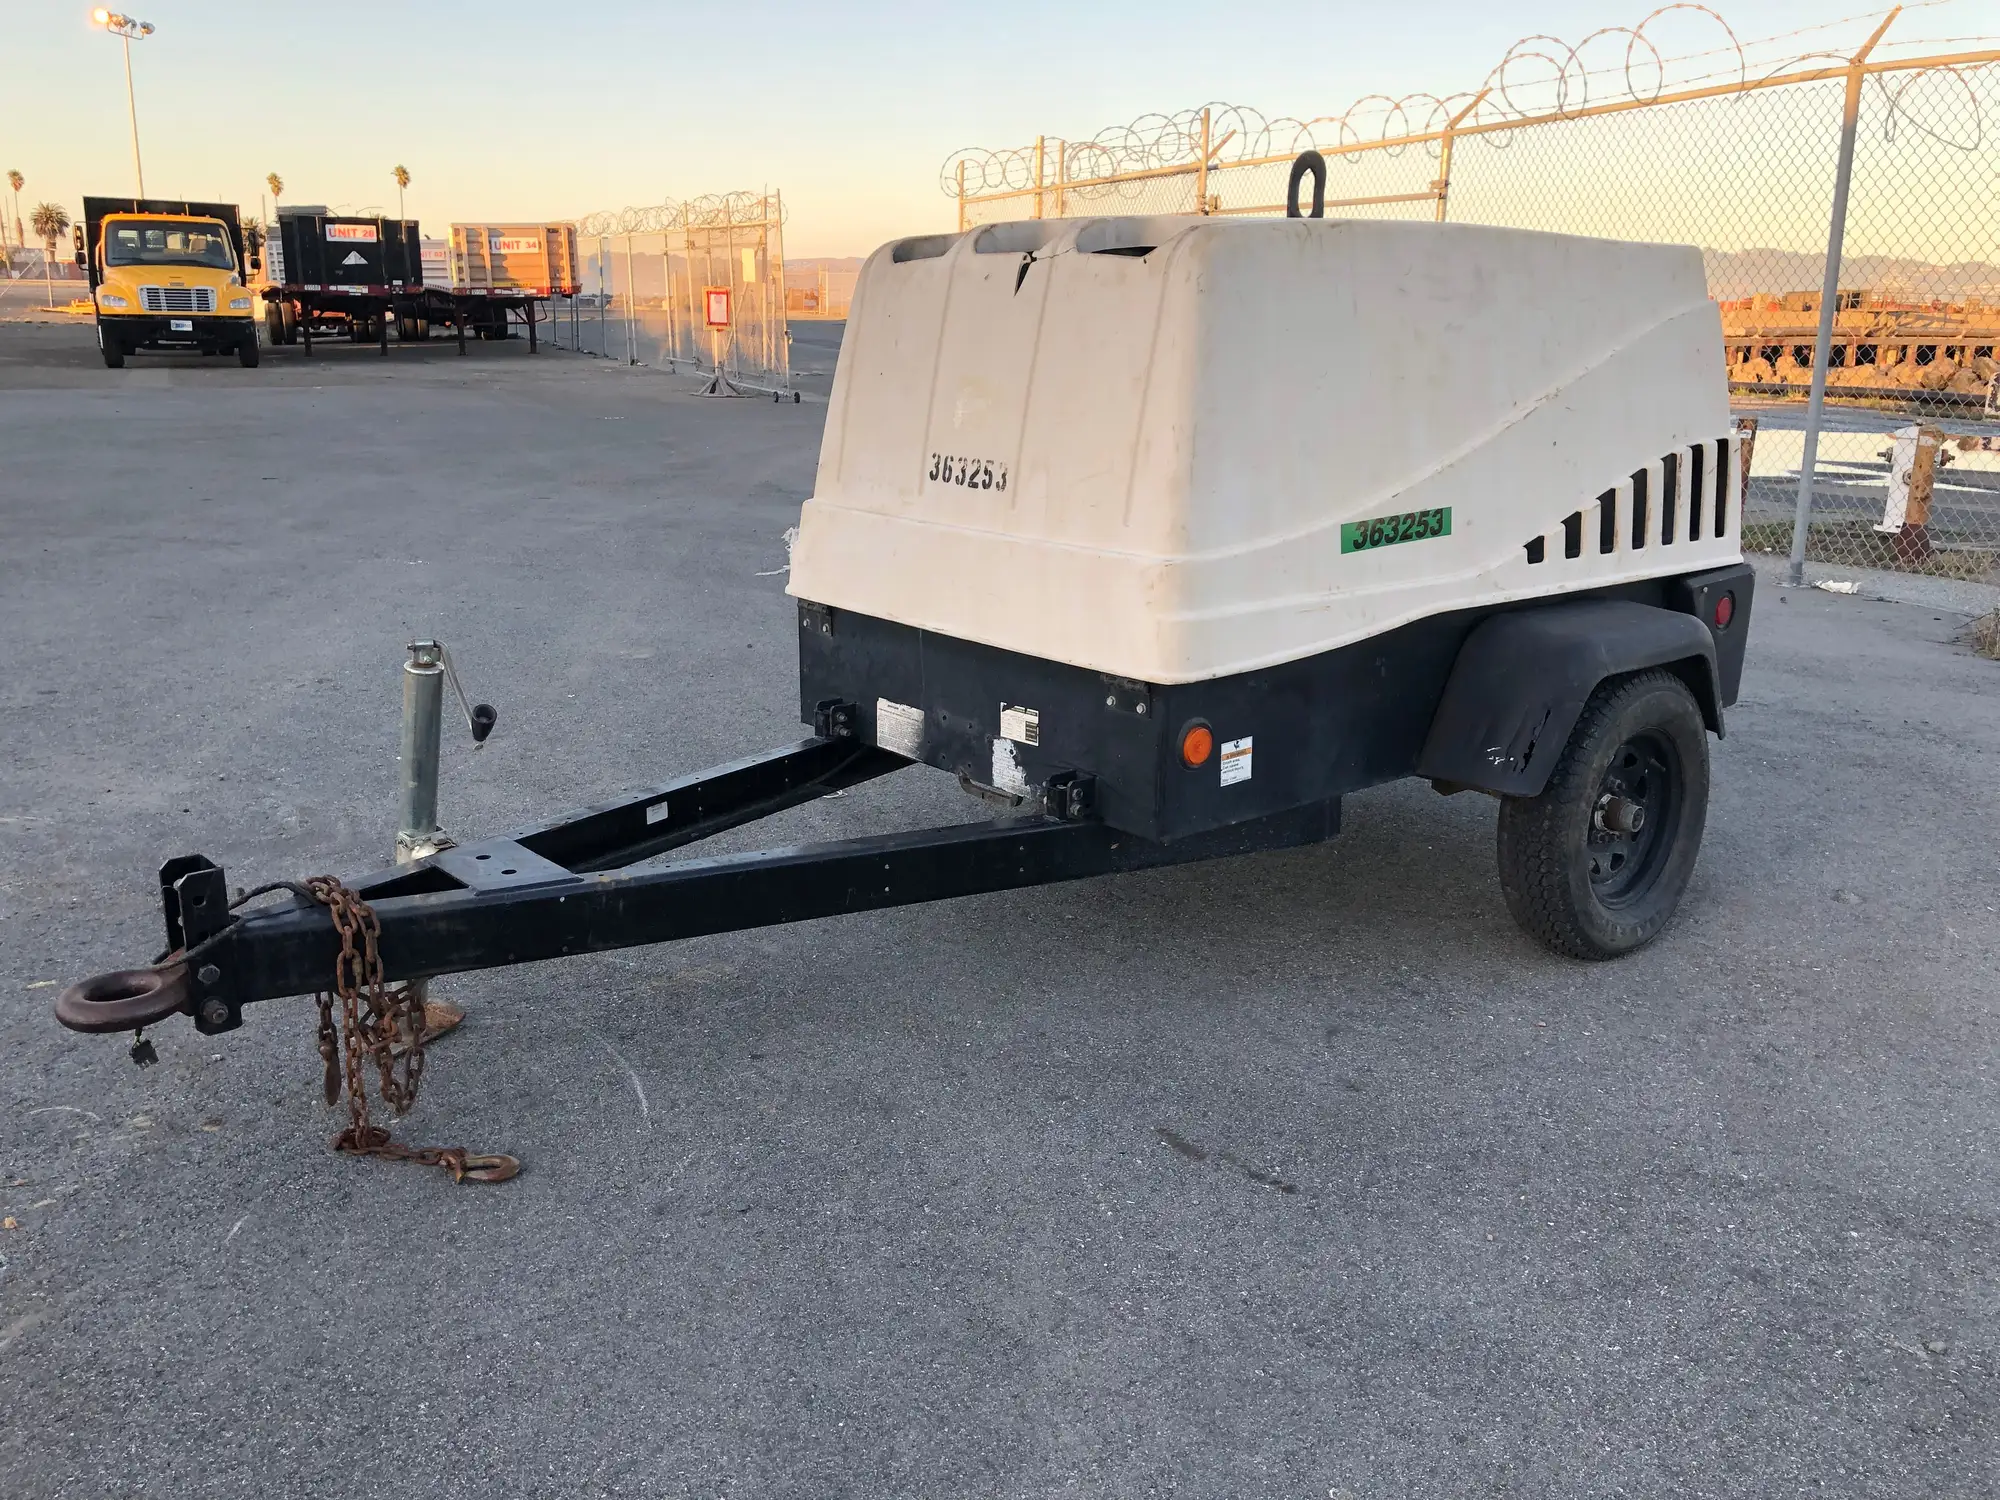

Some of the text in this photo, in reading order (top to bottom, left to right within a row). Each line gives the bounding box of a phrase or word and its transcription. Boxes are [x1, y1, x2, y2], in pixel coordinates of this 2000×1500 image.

[328, 227, 358, 239] UNIT
[494, 240, 537, 250] UNIT 34
[929, 451, 1009, 492] 363253
[1352, 508, 1444, 550] 363253
